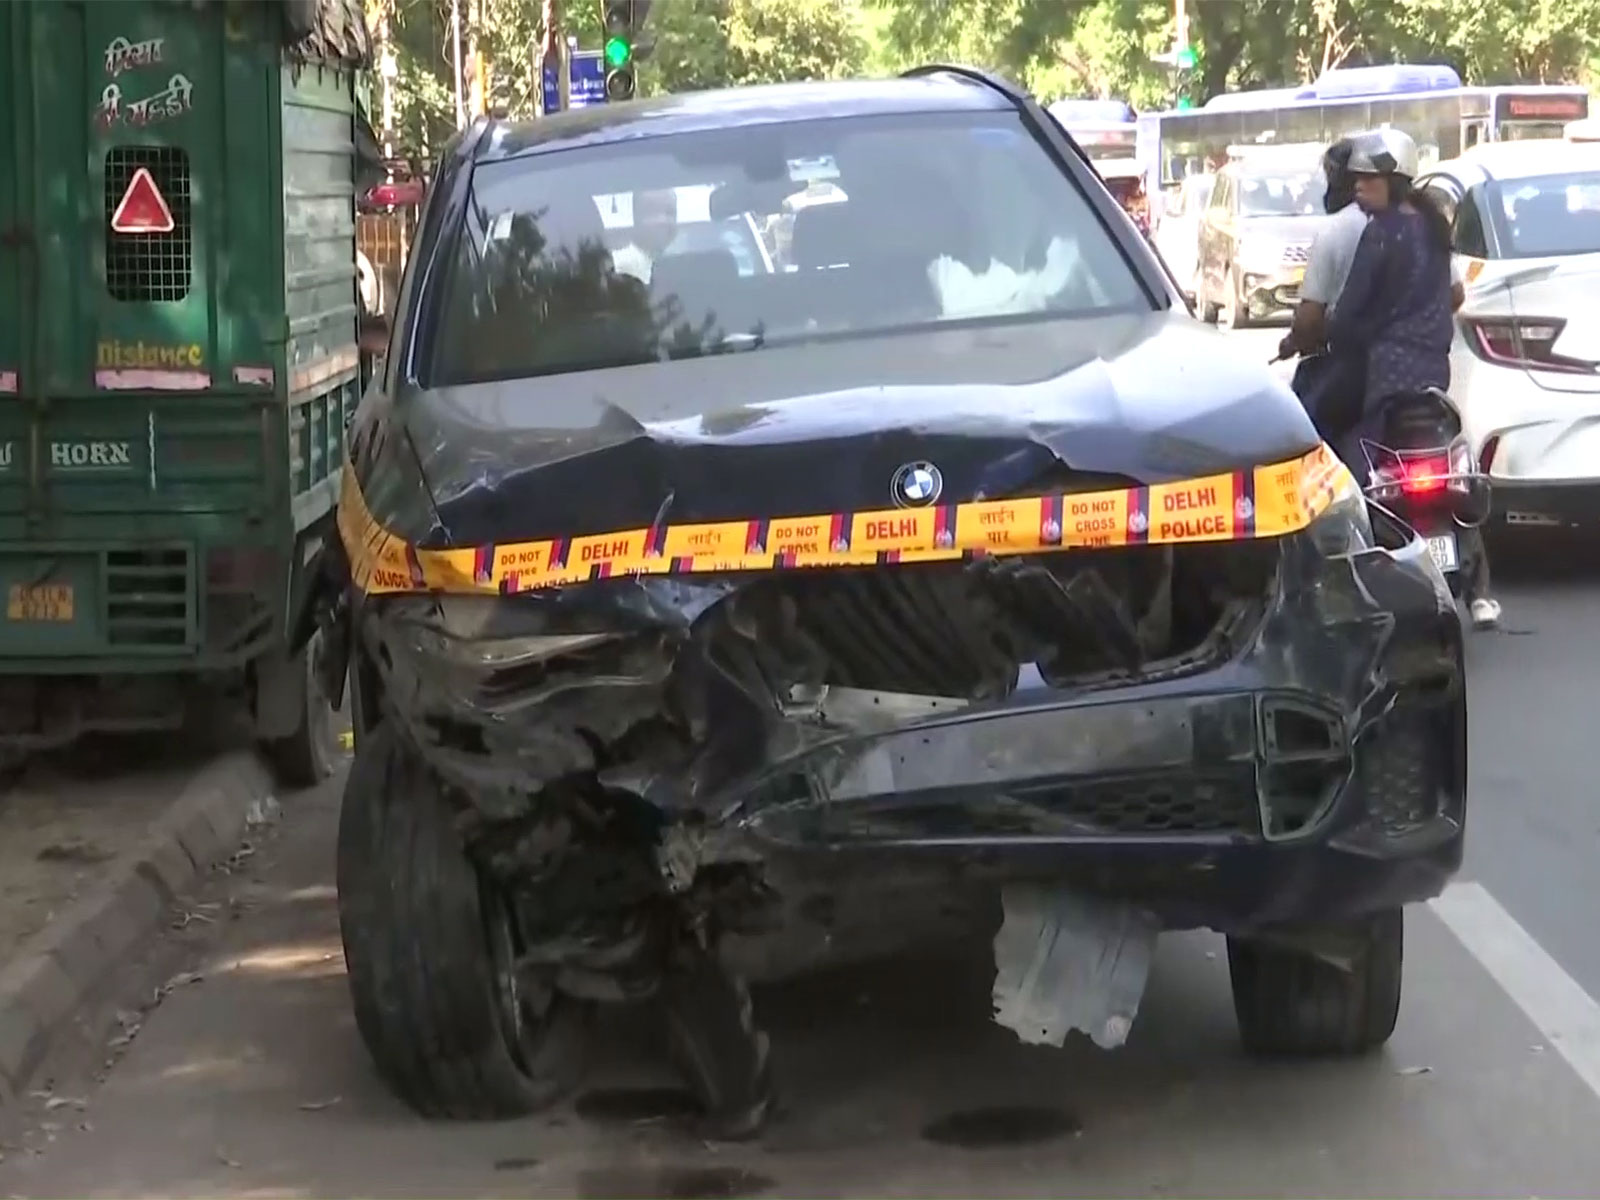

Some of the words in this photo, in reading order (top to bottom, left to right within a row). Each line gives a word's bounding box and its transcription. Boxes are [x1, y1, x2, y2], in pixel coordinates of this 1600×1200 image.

[98, 340, 202, 367] Distance
[51, 441, 130, 466] HORN
[1071, 502, 1088, 516] DO
[1094, 499, 1116, 513] NOT
[1163, 487, 1217, 512] DELHI
[776, 527, 794, 540] DO
[798, 525, 820, 538] NOT
[866, 517, 918, 541] DELHI
[1075, 519, 1116, 533] CROSS
[1160, 515, 1227, 539] POLICE
[501, 553, 516, 567] DO
[519, 550, 541, 564] NOT
[581, 540, 629, 562] DELHI
[778, 542, 819, 555] CROSS
